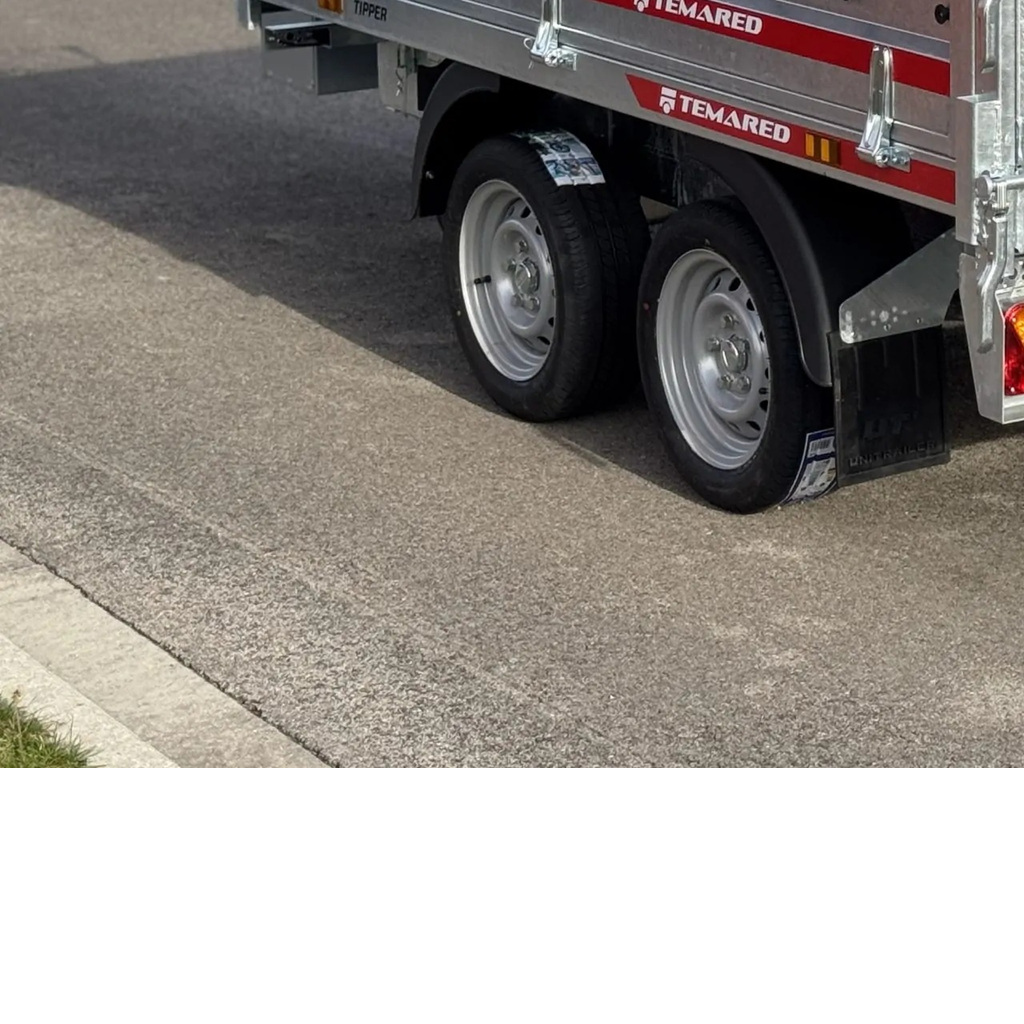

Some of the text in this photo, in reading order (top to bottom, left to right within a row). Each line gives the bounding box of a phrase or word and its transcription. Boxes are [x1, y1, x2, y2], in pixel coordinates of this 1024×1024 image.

[354, 0, 388, 22] TIPPER
[680, 95, 790, 144] TEMARED
[849, 440, 936, 467] UNITRAILER
